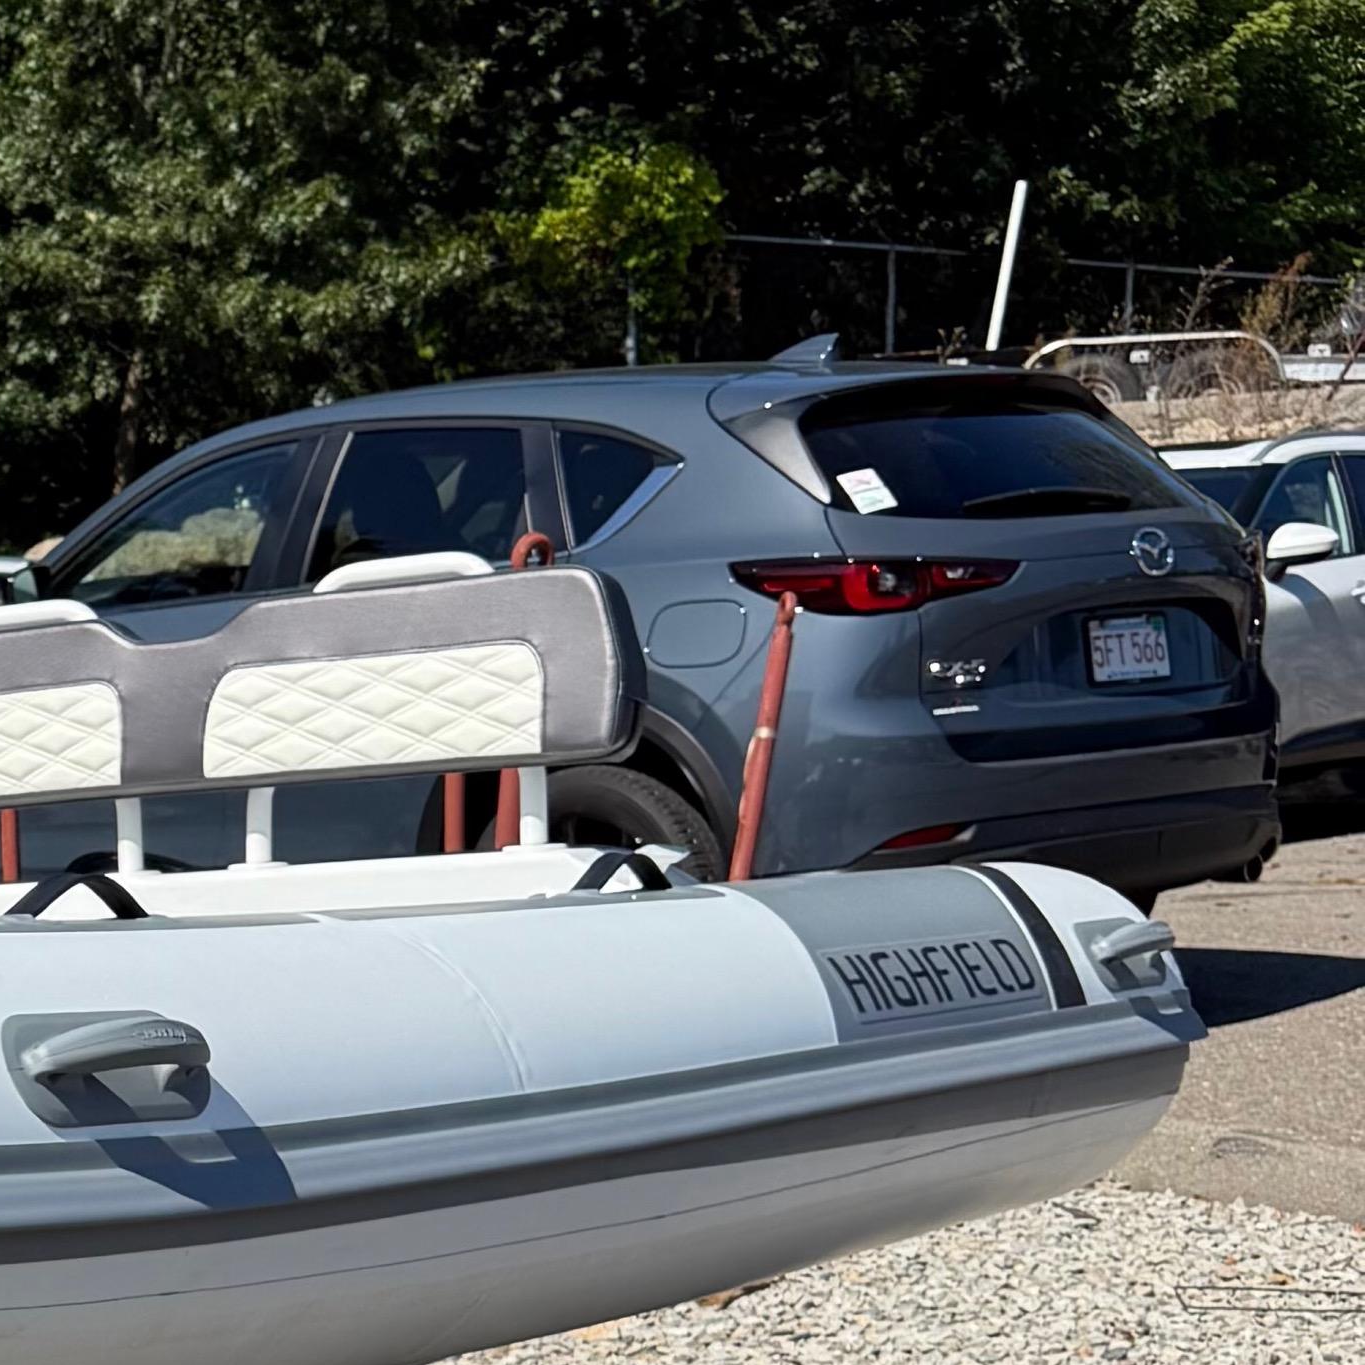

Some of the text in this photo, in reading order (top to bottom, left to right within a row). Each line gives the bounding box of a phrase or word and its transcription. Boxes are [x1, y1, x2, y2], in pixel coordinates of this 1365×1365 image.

[1092, 630, 1166, 668] 5FT 566
[826, 939, 1036, 1013] HIGHFIELD
